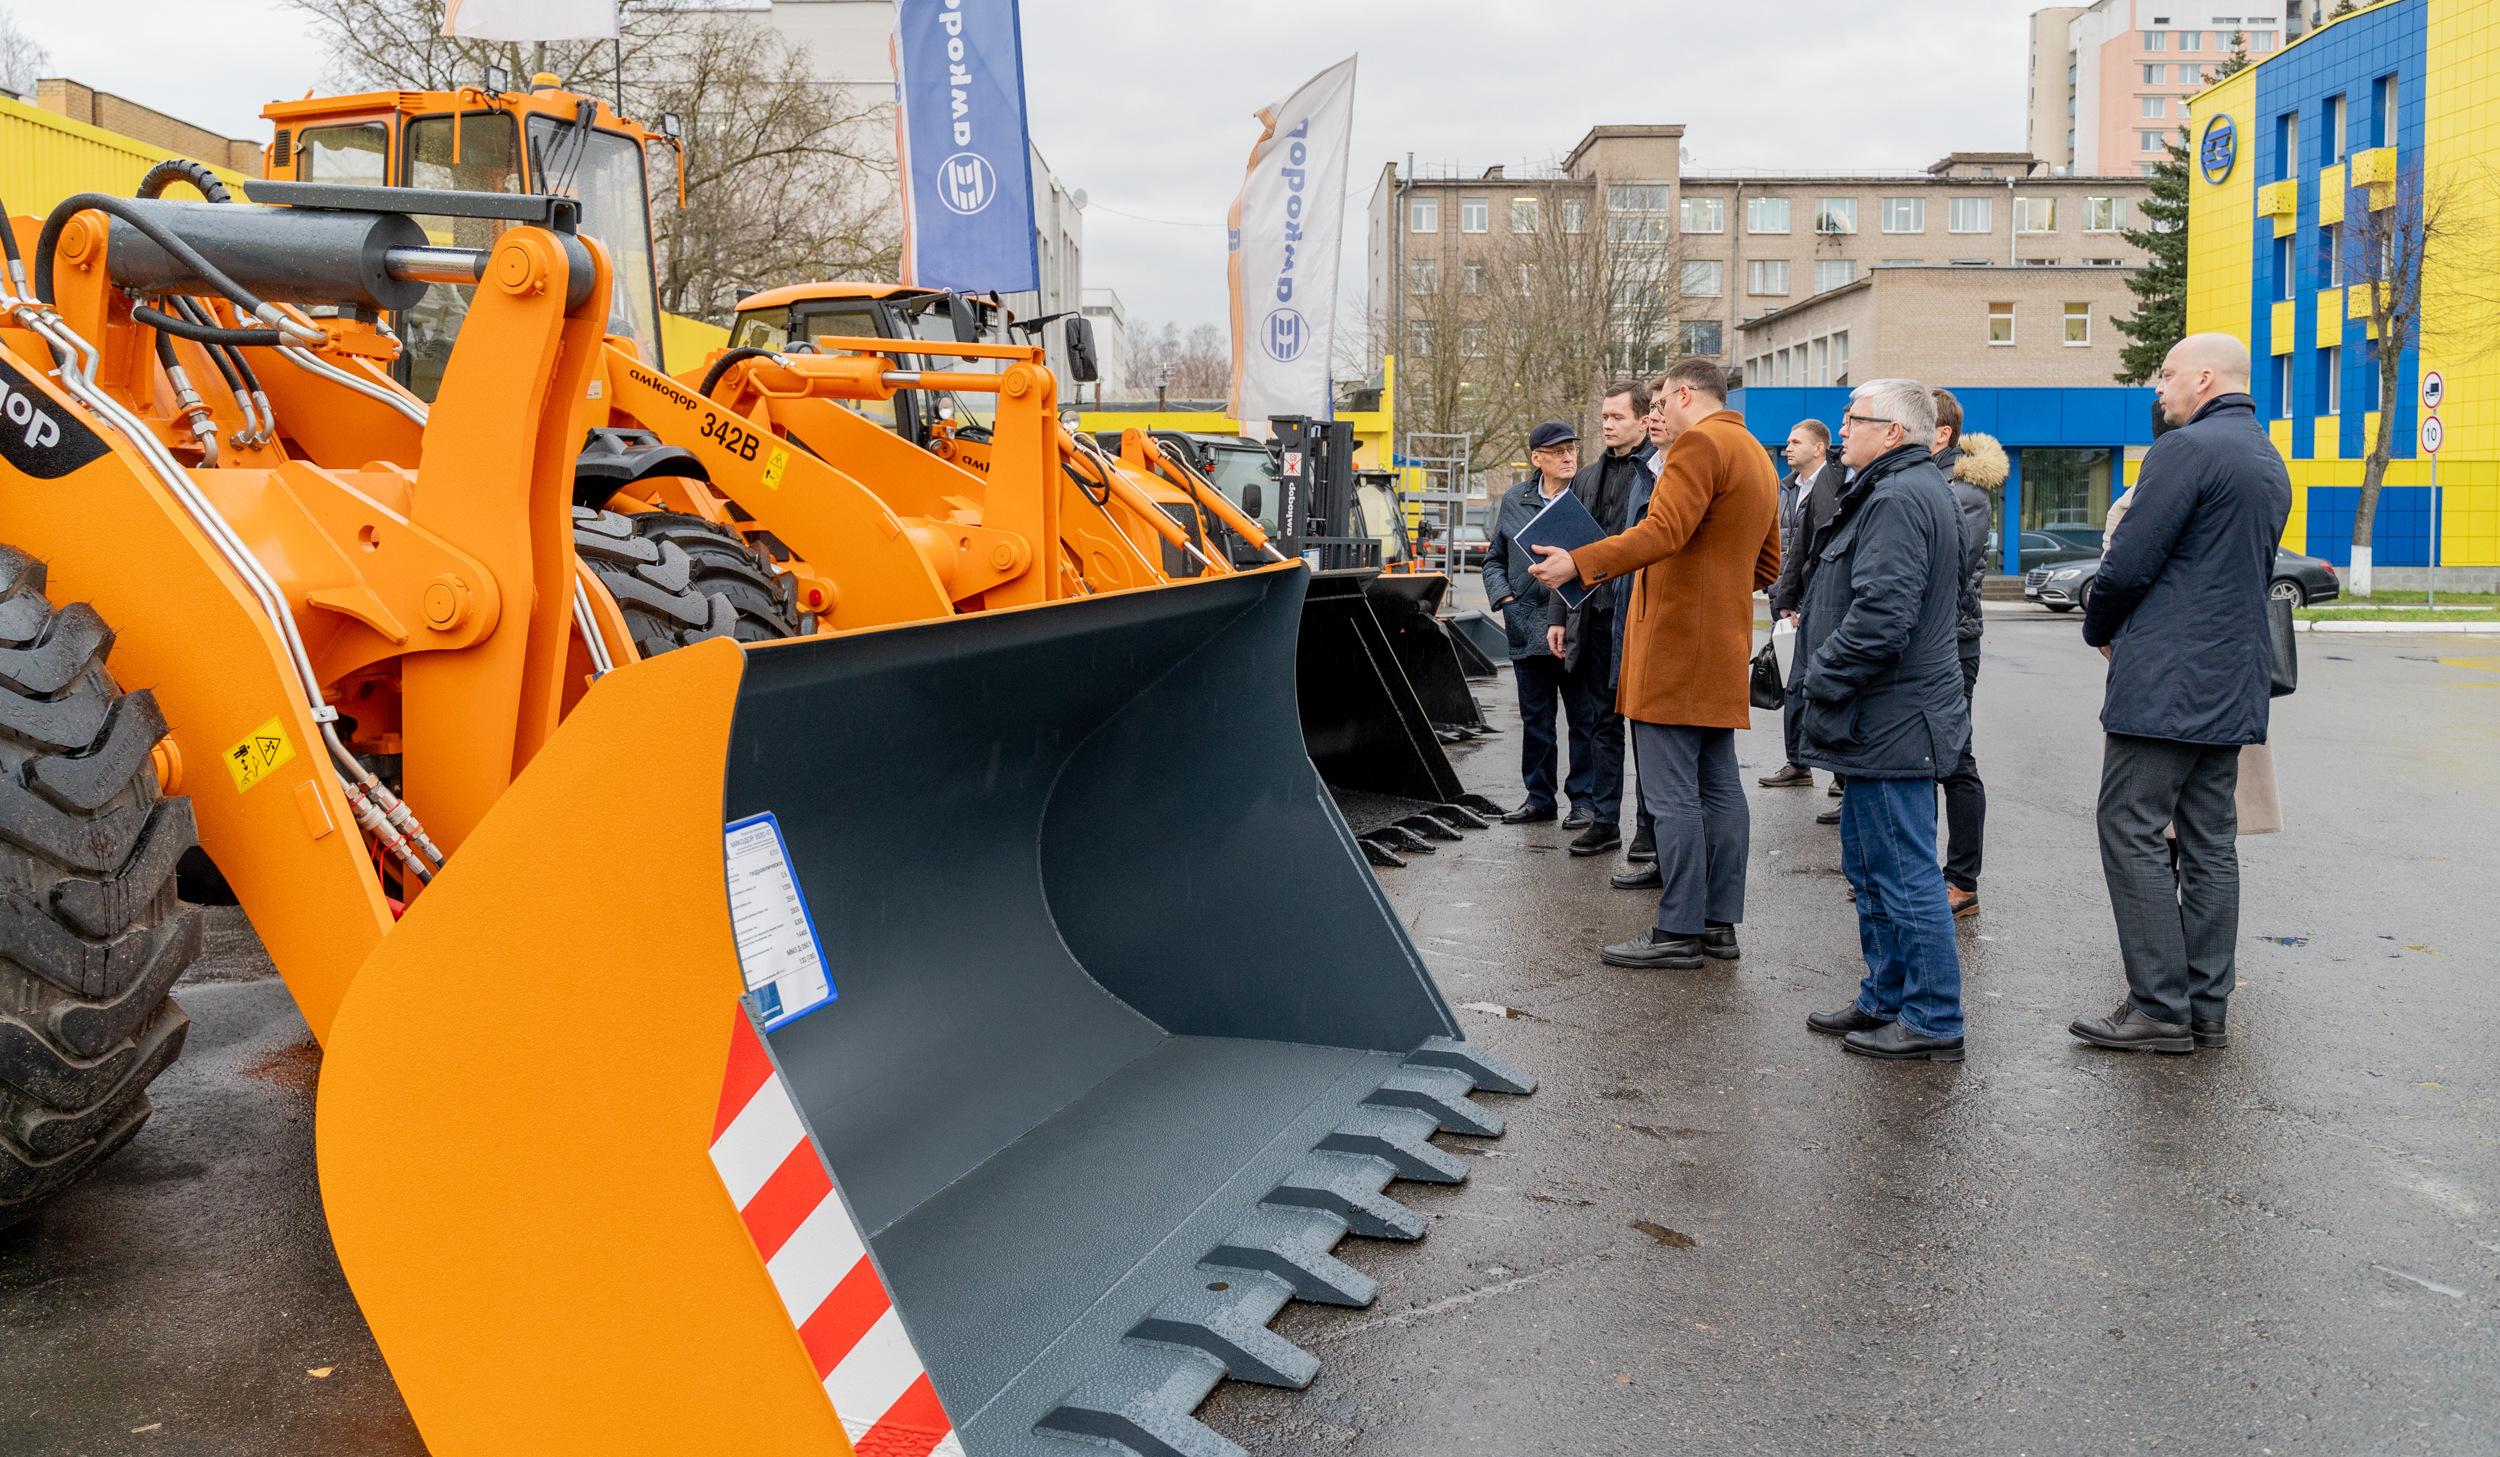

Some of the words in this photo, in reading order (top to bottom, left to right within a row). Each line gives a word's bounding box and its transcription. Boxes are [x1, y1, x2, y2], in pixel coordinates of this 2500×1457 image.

[629, 369, 697, 410] амкодор
[2426, 427, 2437, 442] 10
[1286, 482, 1297, 537] амкодор
